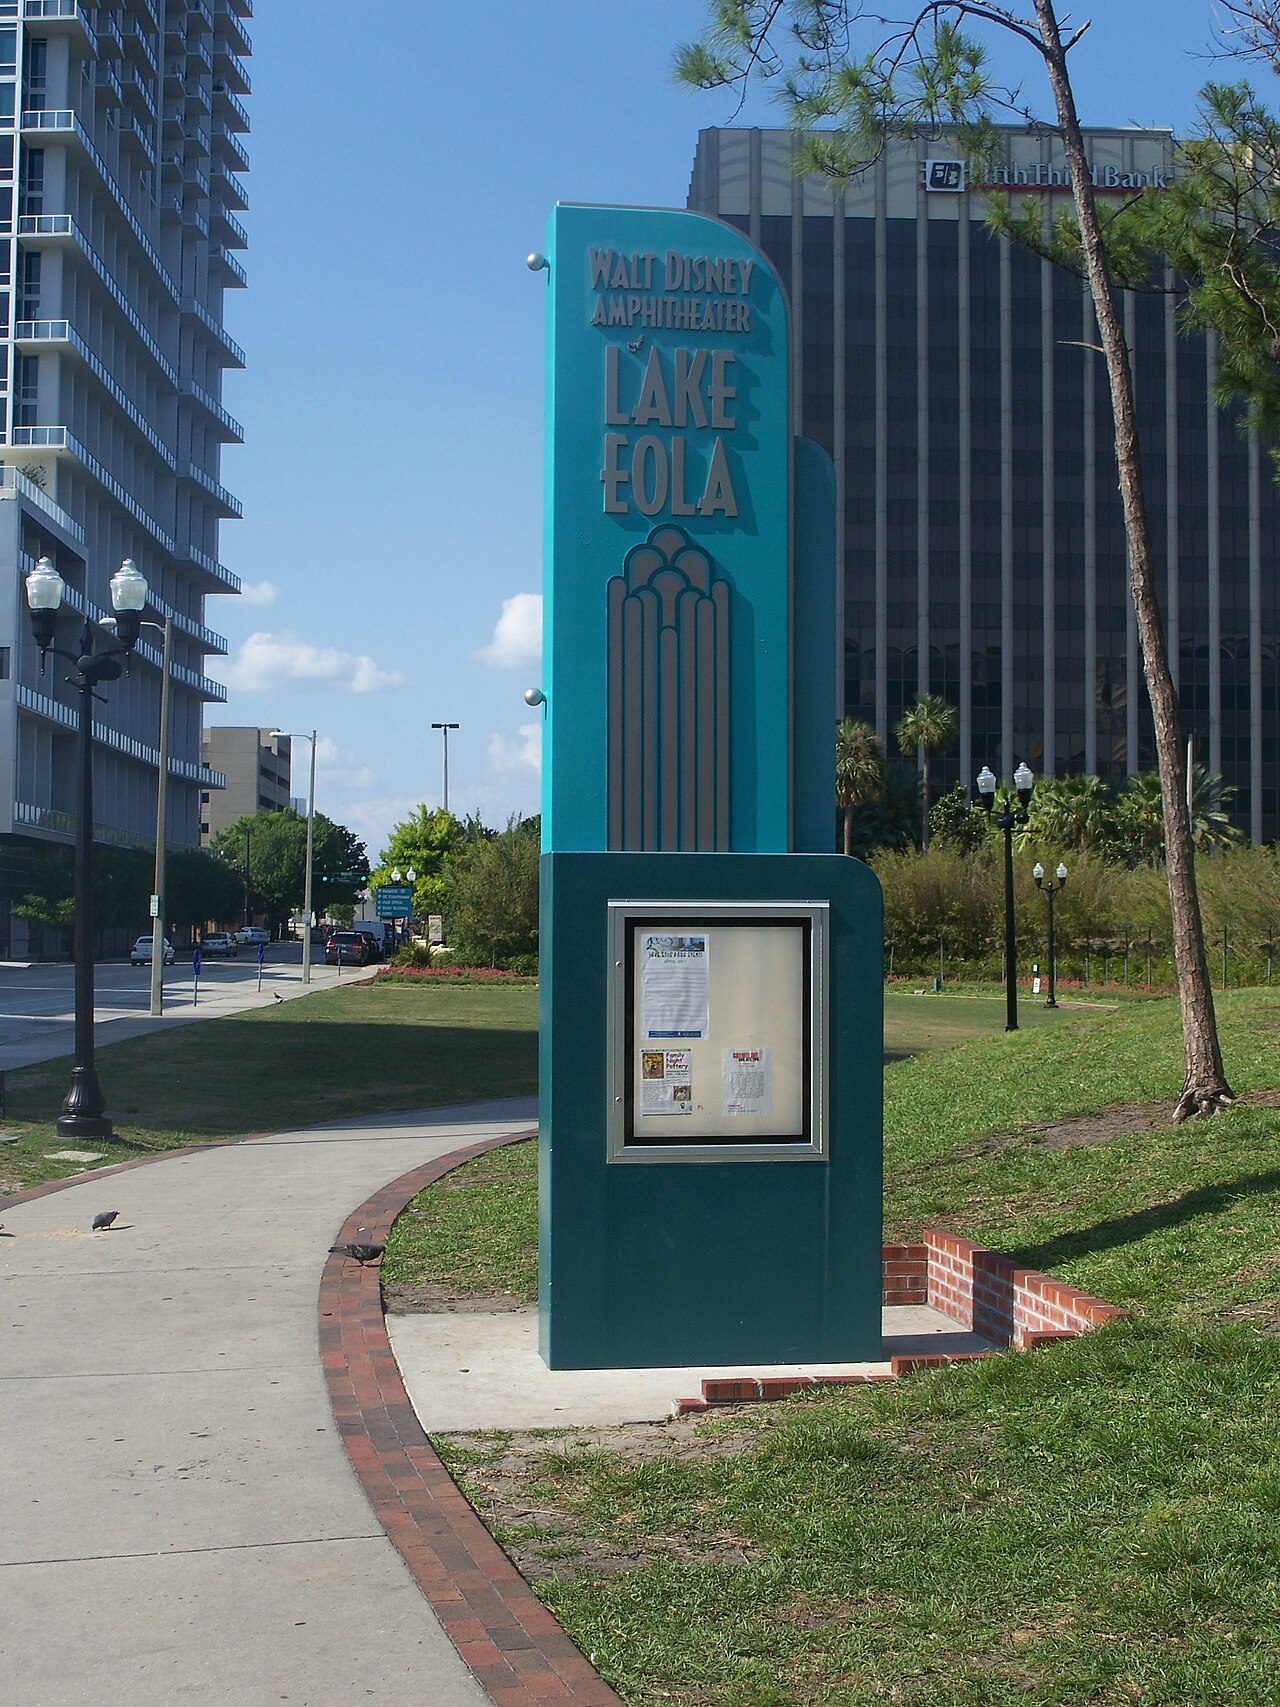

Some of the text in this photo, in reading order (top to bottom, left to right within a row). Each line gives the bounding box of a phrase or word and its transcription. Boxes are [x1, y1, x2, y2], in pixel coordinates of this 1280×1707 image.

[1030, 162, 1098, 187] Thid
[1104, 165, 1167, 189] Bank
[588, 247, 754, 295] WALT DISNEY
[591, 296, 750, 332] AMPHITHEATER
[604, 345, 736, 429] LAKE
[600, 433, 738, 517] EOLA
